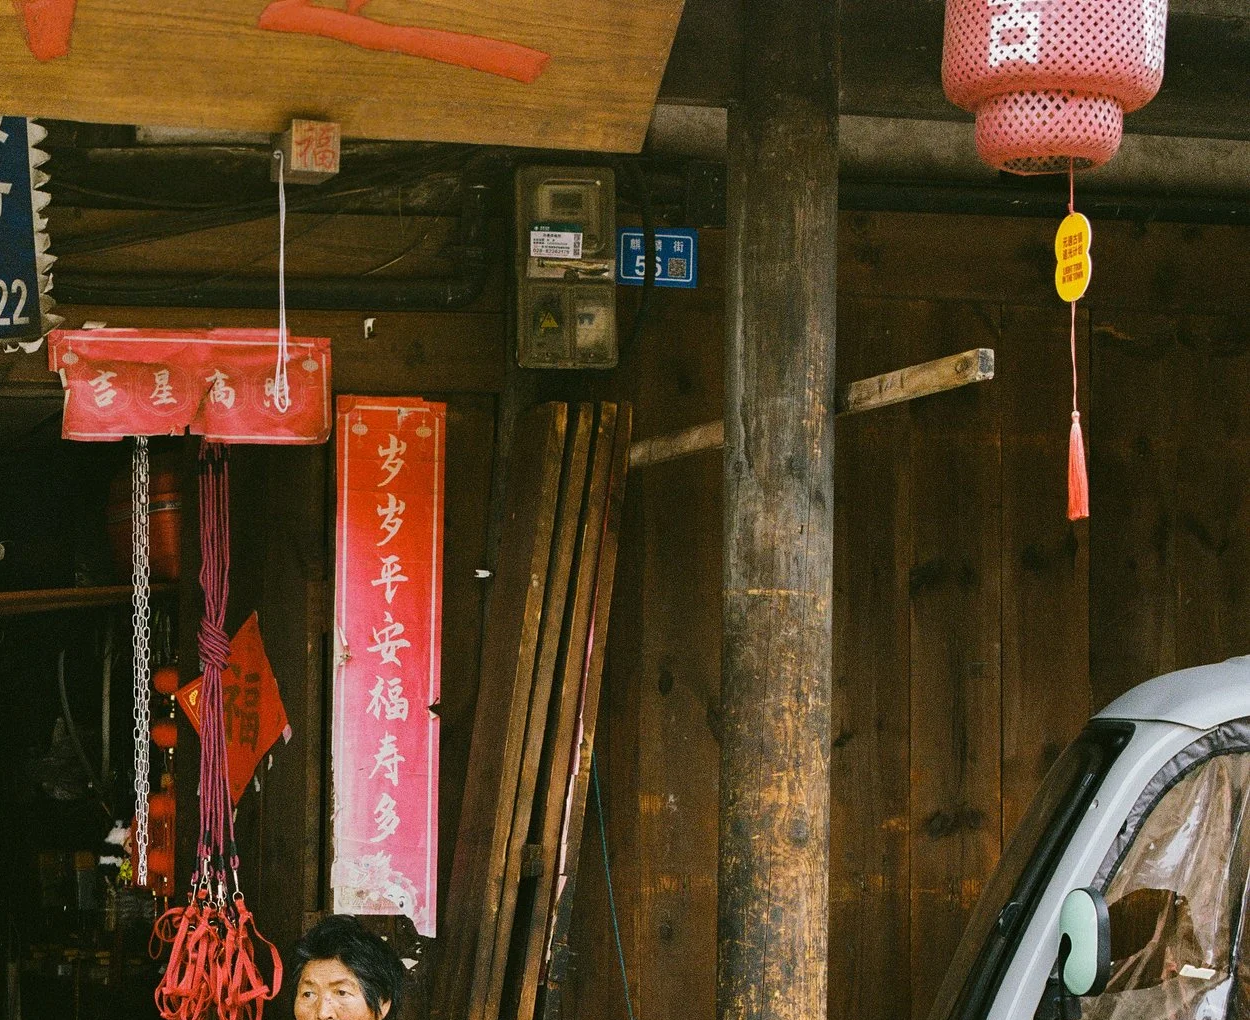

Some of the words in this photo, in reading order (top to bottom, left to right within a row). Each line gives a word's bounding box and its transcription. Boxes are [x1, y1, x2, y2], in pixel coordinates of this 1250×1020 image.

[366, 433, 411, 843] 岁岁平安福寿多
